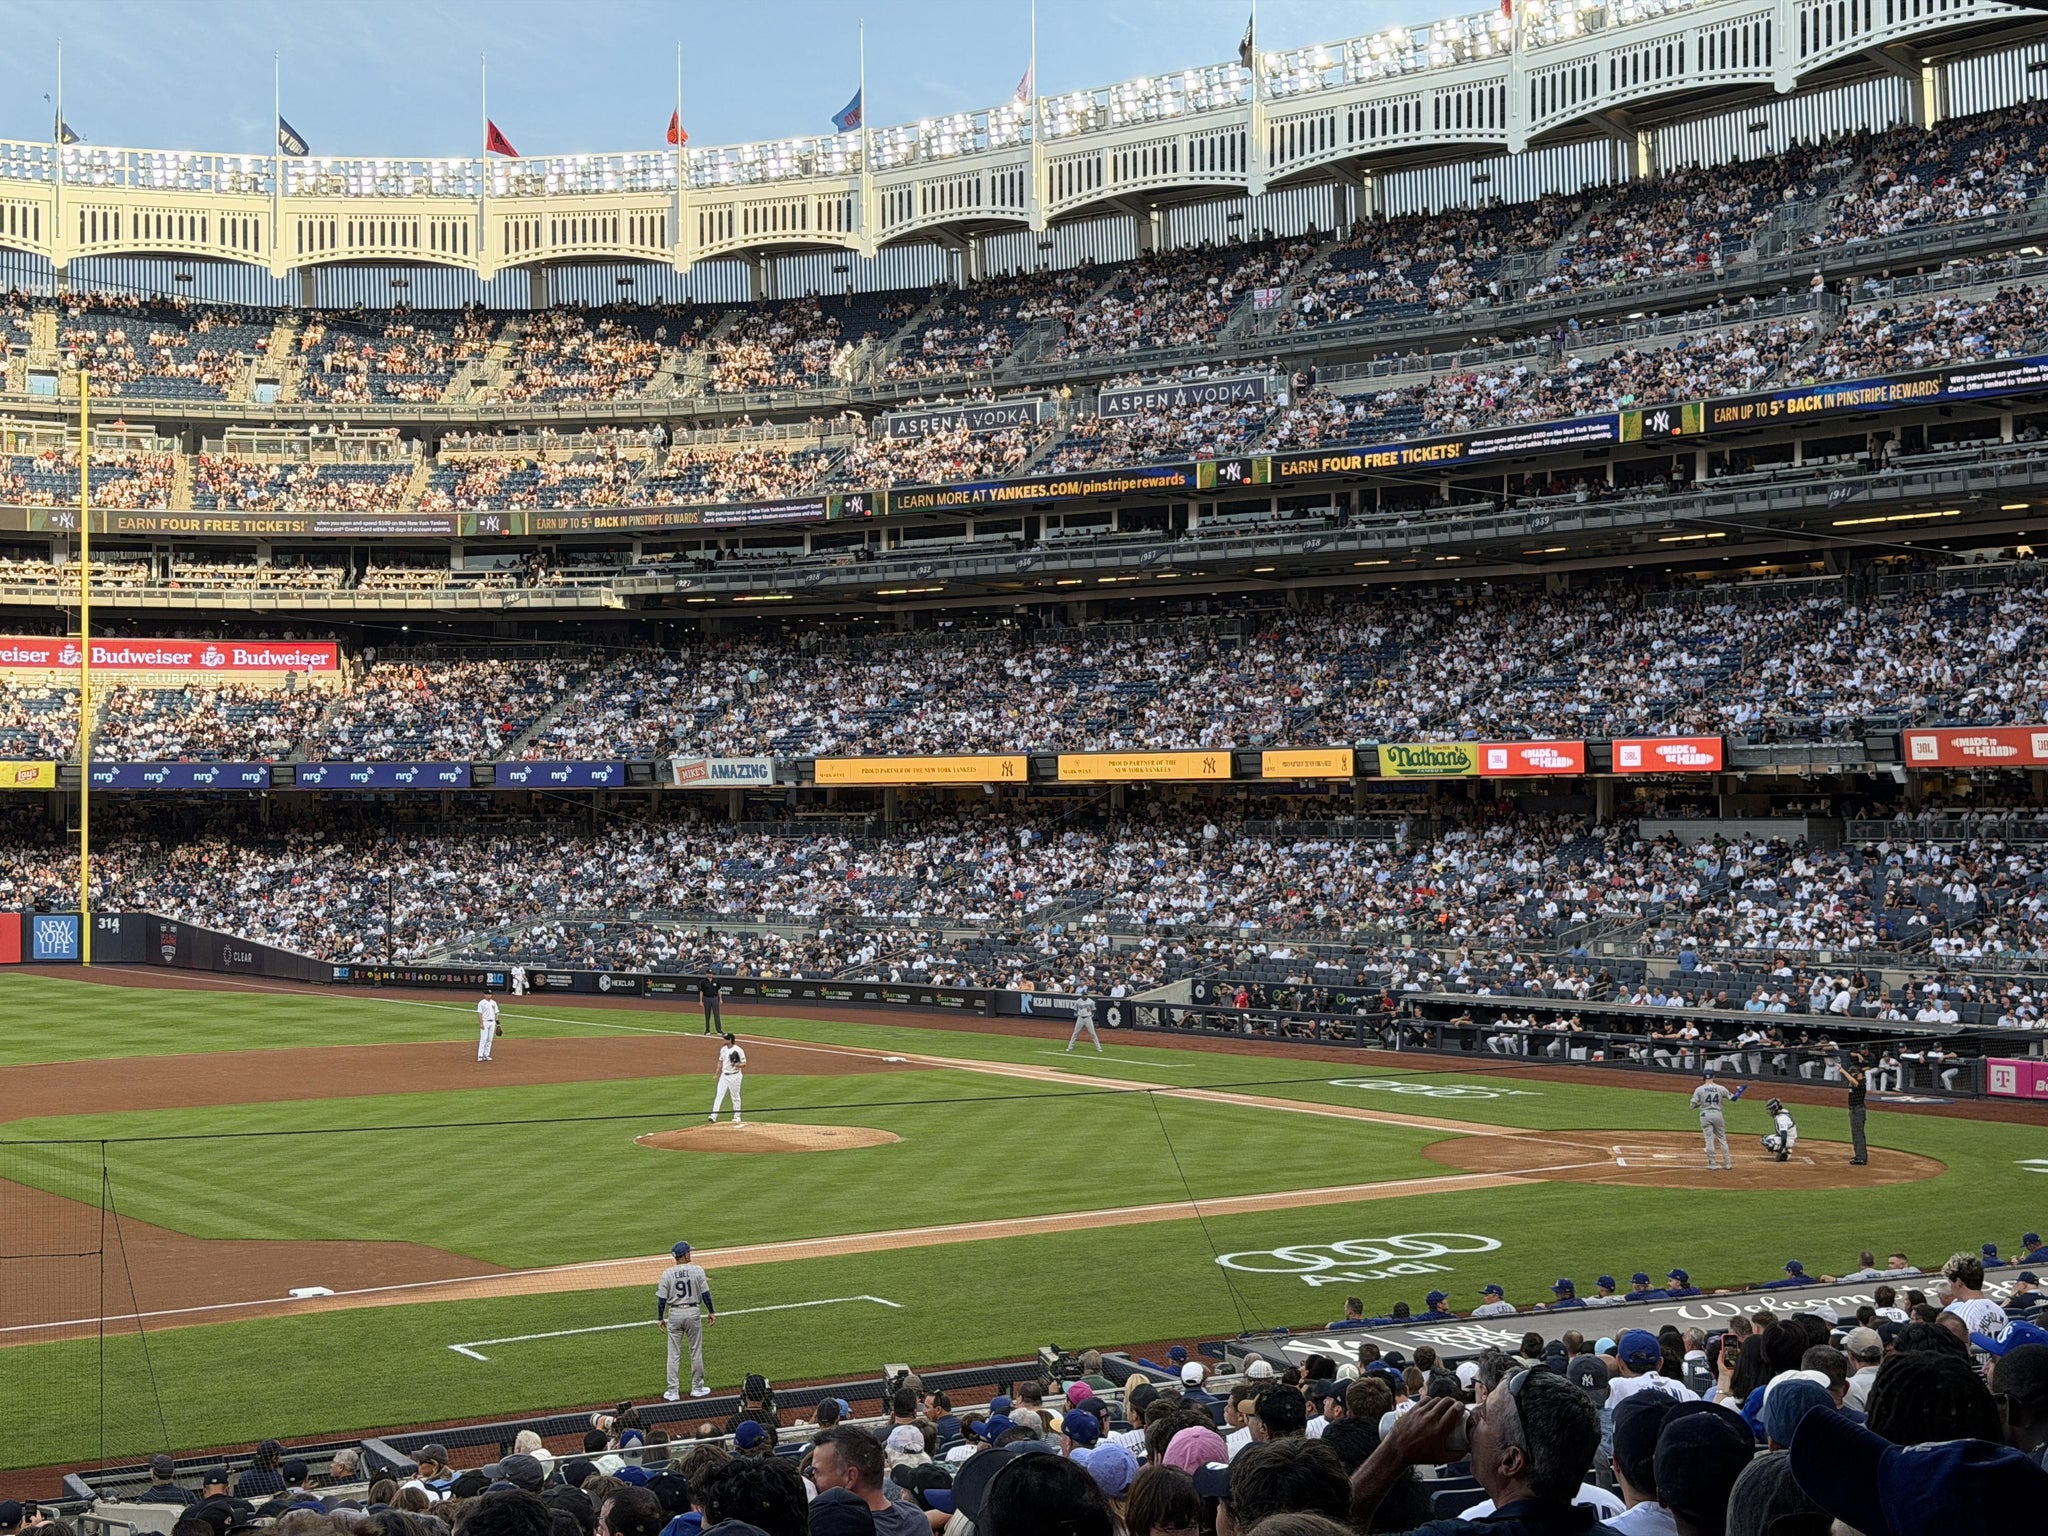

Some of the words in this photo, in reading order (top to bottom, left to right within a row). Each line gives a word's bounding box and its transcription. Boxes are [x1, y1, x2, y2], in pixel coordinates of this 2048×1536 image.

[1966, 372, 1997, 384] purchase
[1997, 371, 2006, 379] on
[2006, 368, 2022, 378] your
[2022, 365, 2038, 375] New
[1983, 379, 2007, 389] limited
[2007, 378, 2015, 386] to
[2016, 375, 2041, 385] Yankee
[1108, 393, 1168, 413] ASPEN
[1192, 383, 1256, 403] VODKA
[1713, 405, 1739, 424] EARN
[1740, 404, 1754, 420] UP
[1755, 402, 1769, 418] TO
[1786, 396, 1823, 414] BACK
[1824, 394, 1836, 410] IN
[1836, 387, 1888, 407] PINSTRIPE
[897, 415, 952, 435] ASPEN
[973, 407, 1030, 428] VODKA
[1575, 426, 1588, 435] York
[1588, 423, 1611, 433] Yankees
[1281, 458, 1319, 477] EARN
[1321, 455, 1362, 473] FOUR
[1364, 451, 1399, 470] FREE
[897, 492, 935, 510] LEARN
[936, 490, 970, 508] MORE
[971, 490, 988, 503] AT
[989, 472, 1187, 502] YANKEES.COM/pinstriperewards
[1828, 487, 1850, 502] 1941
[118, 517, 157, 530] EARN
[160, 518, 201, 531] FOUR
[203, 518, 241, 532] FREE
[537, 519, 557, 530] EARN
[558, 518, 569, 529] UP
[570, 518, 580, 529] TO
[594, 515, 620, 528] BACK
[620, 515, 628, 527] IN
[628, 513, 664, 526] PINSTRIPE
[1530, 514, 1550, 529] 1939
[91, 647, 193, 665] Budweiser
[232, 649, 330, 667] Budweiser
[1916, 742, 1934, 754] JBL
[1958, 737, 1989, 747] MADE
[1387, 745, 1471, 768] Nathan's
[1661, 745, 1689, 756] MADE
[1976, 746, 2010, 758] HEARD
[1677, 753, 1708, 766] HEARD
[93, 772, 113, 784] nrg
[144, 771, 164, 784] nrg
[193, 772, 214, 784] nrg
[242, 772, 262, 784] nrg
[303, 772, 323, 784] nrg
[350, 772, 369, 784] nrg
[395, 772, 414, 784] nrg
[439, 771, 458, 783] nrg
[510, 771, 527, 783] nrg
[551, 771, 568, 782] nrg
[591, 770, 608, 782] nrg
[682, 766, 706, 780] MIKE'S
[711, 764, 769, 779] AMAZING
[41, 920, 72, 933] NEW
[98, 918, 120, 929] 314
[35, 930, 75, 944] YORK
[40, 941, 71, 954] LIFE
[233, 951, 253, 963] CLEAR
[611, 979, 636, 988] HEXCLAD
[1033, 997, 1052, 1008] KEAN
[1996, 1070, 2010, 1088] T
[1704, 1094, 1720, 1105] 44
[674, 1270, 690, 1279] EBEL
[1300, 1261, 1455, 1287] Audi
[675, 1279, 693, 1299] 91
